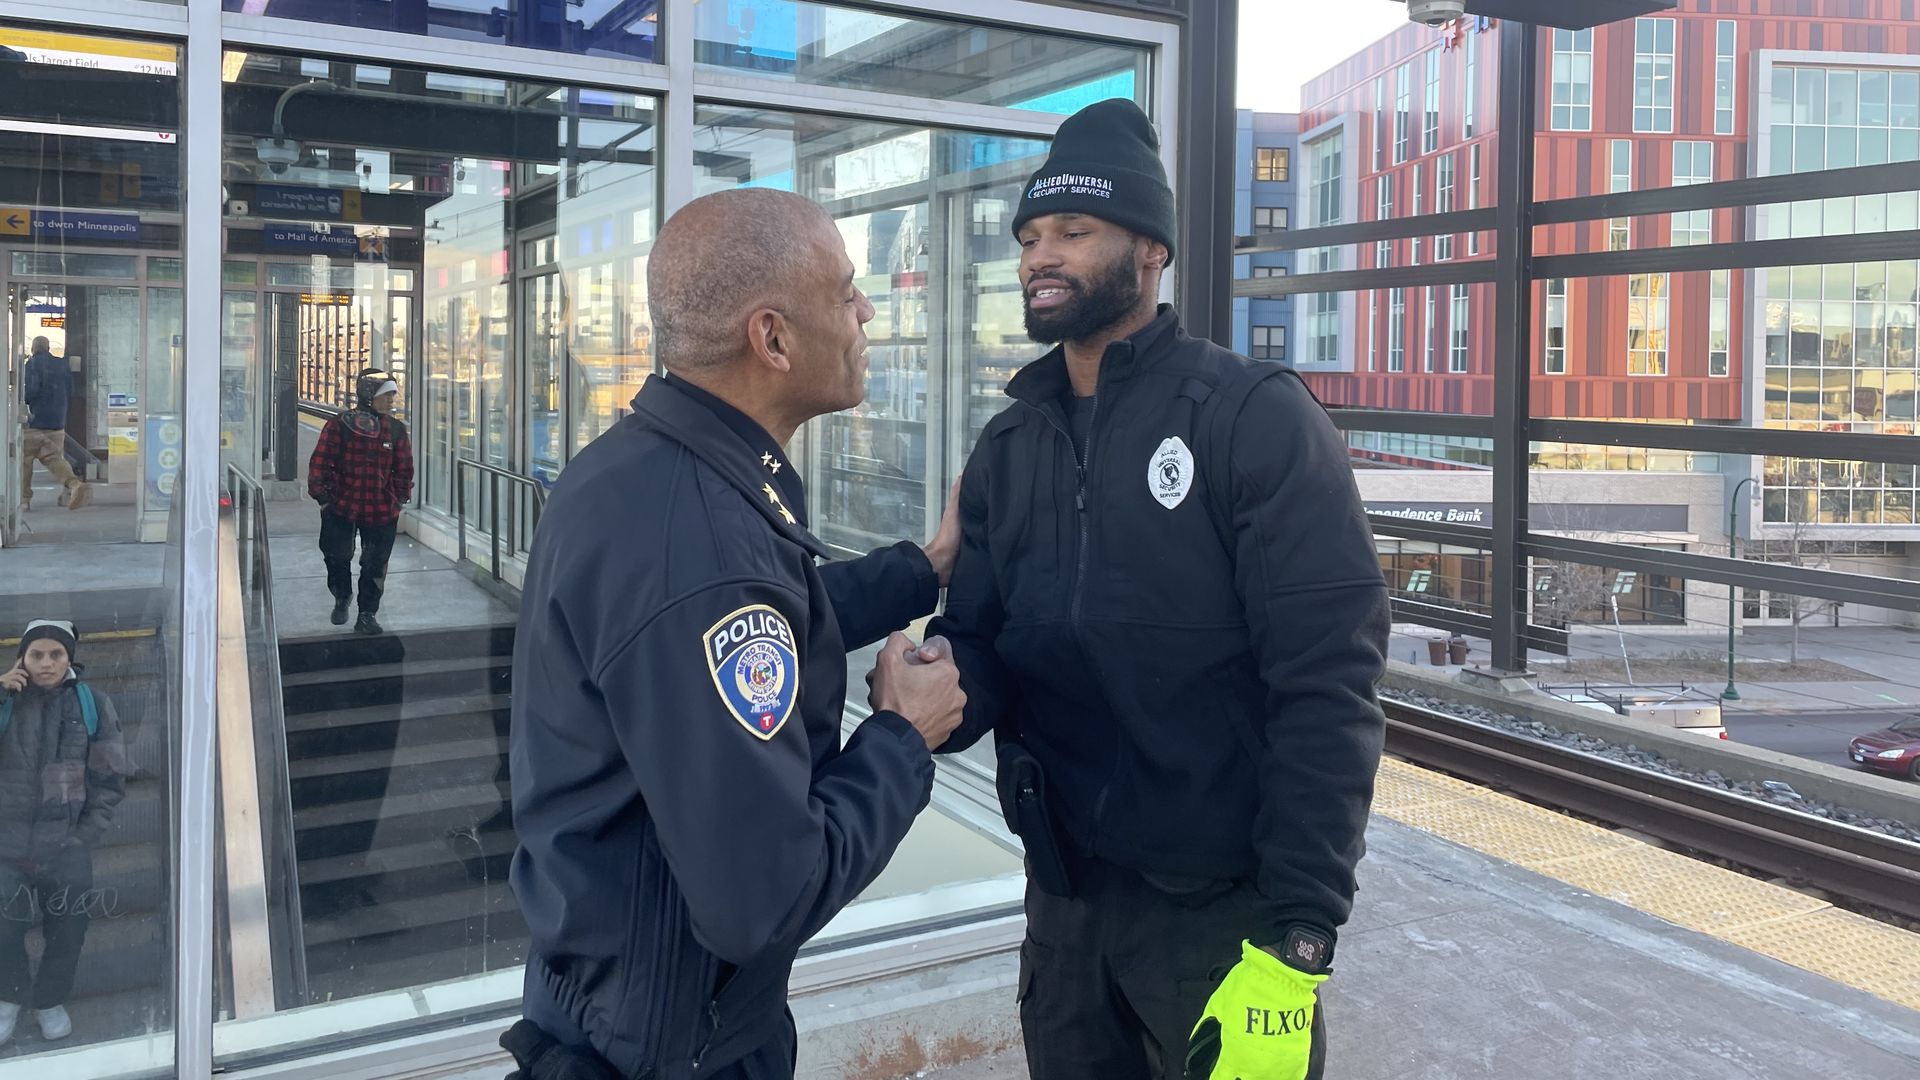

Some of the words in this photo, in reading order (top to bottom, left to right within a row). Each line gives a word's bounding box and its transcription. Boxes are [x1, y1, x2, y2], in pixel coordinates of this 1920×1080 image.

[155, 66, 172, 76] Min
[1033, 186, 1067, 199] SECURITY
[1071, 186, 1110, 199] SERVICES
[33, 220, 45, 229] to
[47, 219, 74, 229] dwtn
[77, 220, 137, 233] Minneapolis
[274, 232, 285, 241] to
[287, 232, 306, 241] Mall
[308, 233, 318, 242] of
[320, 234, 357, 245] America
[1446, 508, 1483, 522] Bank
[714, 612, 790, 660] POLICE
[737, 647, 756, 675] METRO
[757, 644, 783, 666] TRANSIT
[752, 691, 777, 703] POLICE
